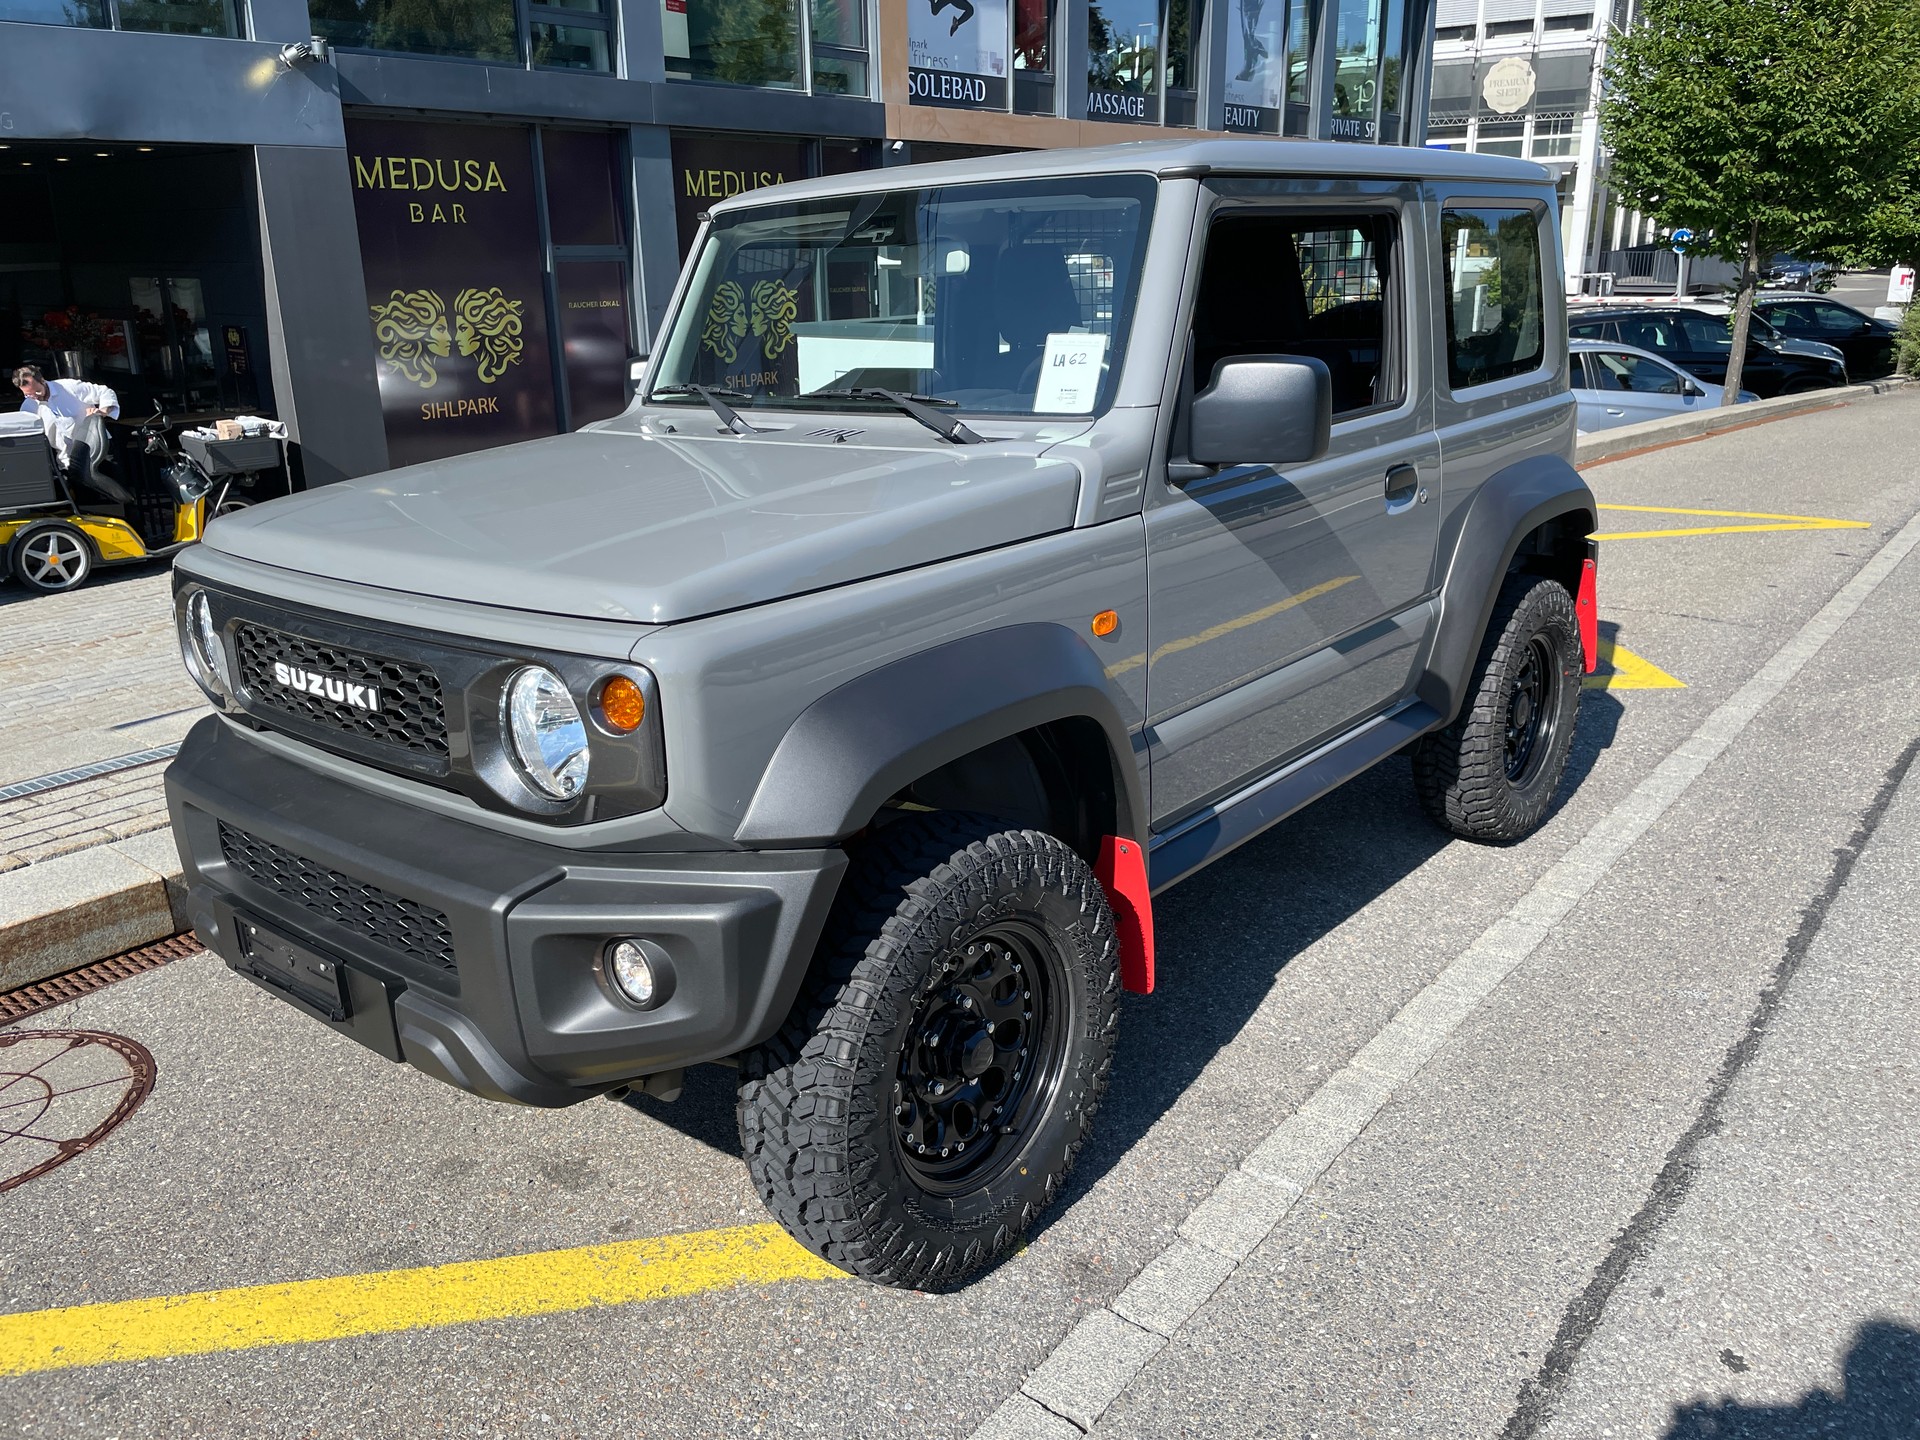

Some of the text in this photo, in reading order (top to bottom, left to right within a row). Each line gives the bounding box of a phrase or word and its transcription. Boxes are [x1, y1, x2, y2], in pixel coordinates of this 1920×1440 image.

[908, 72, 986, 102] SOLEBAD
[1365, 121, 1382, 138] SP
[354, 156, 507, 192] MEDUSA
[409, 203, 467, 224] BAR
[568, 300, 620, 309] RAUCHER LOKAL
[1053, 352, 1087, 367] LA 62
[725, 371, 778, 389] SIHLPARK
[421, 397, 499, 420] SIHLPARK
[275, 661, 378, 711] SUZUKI
